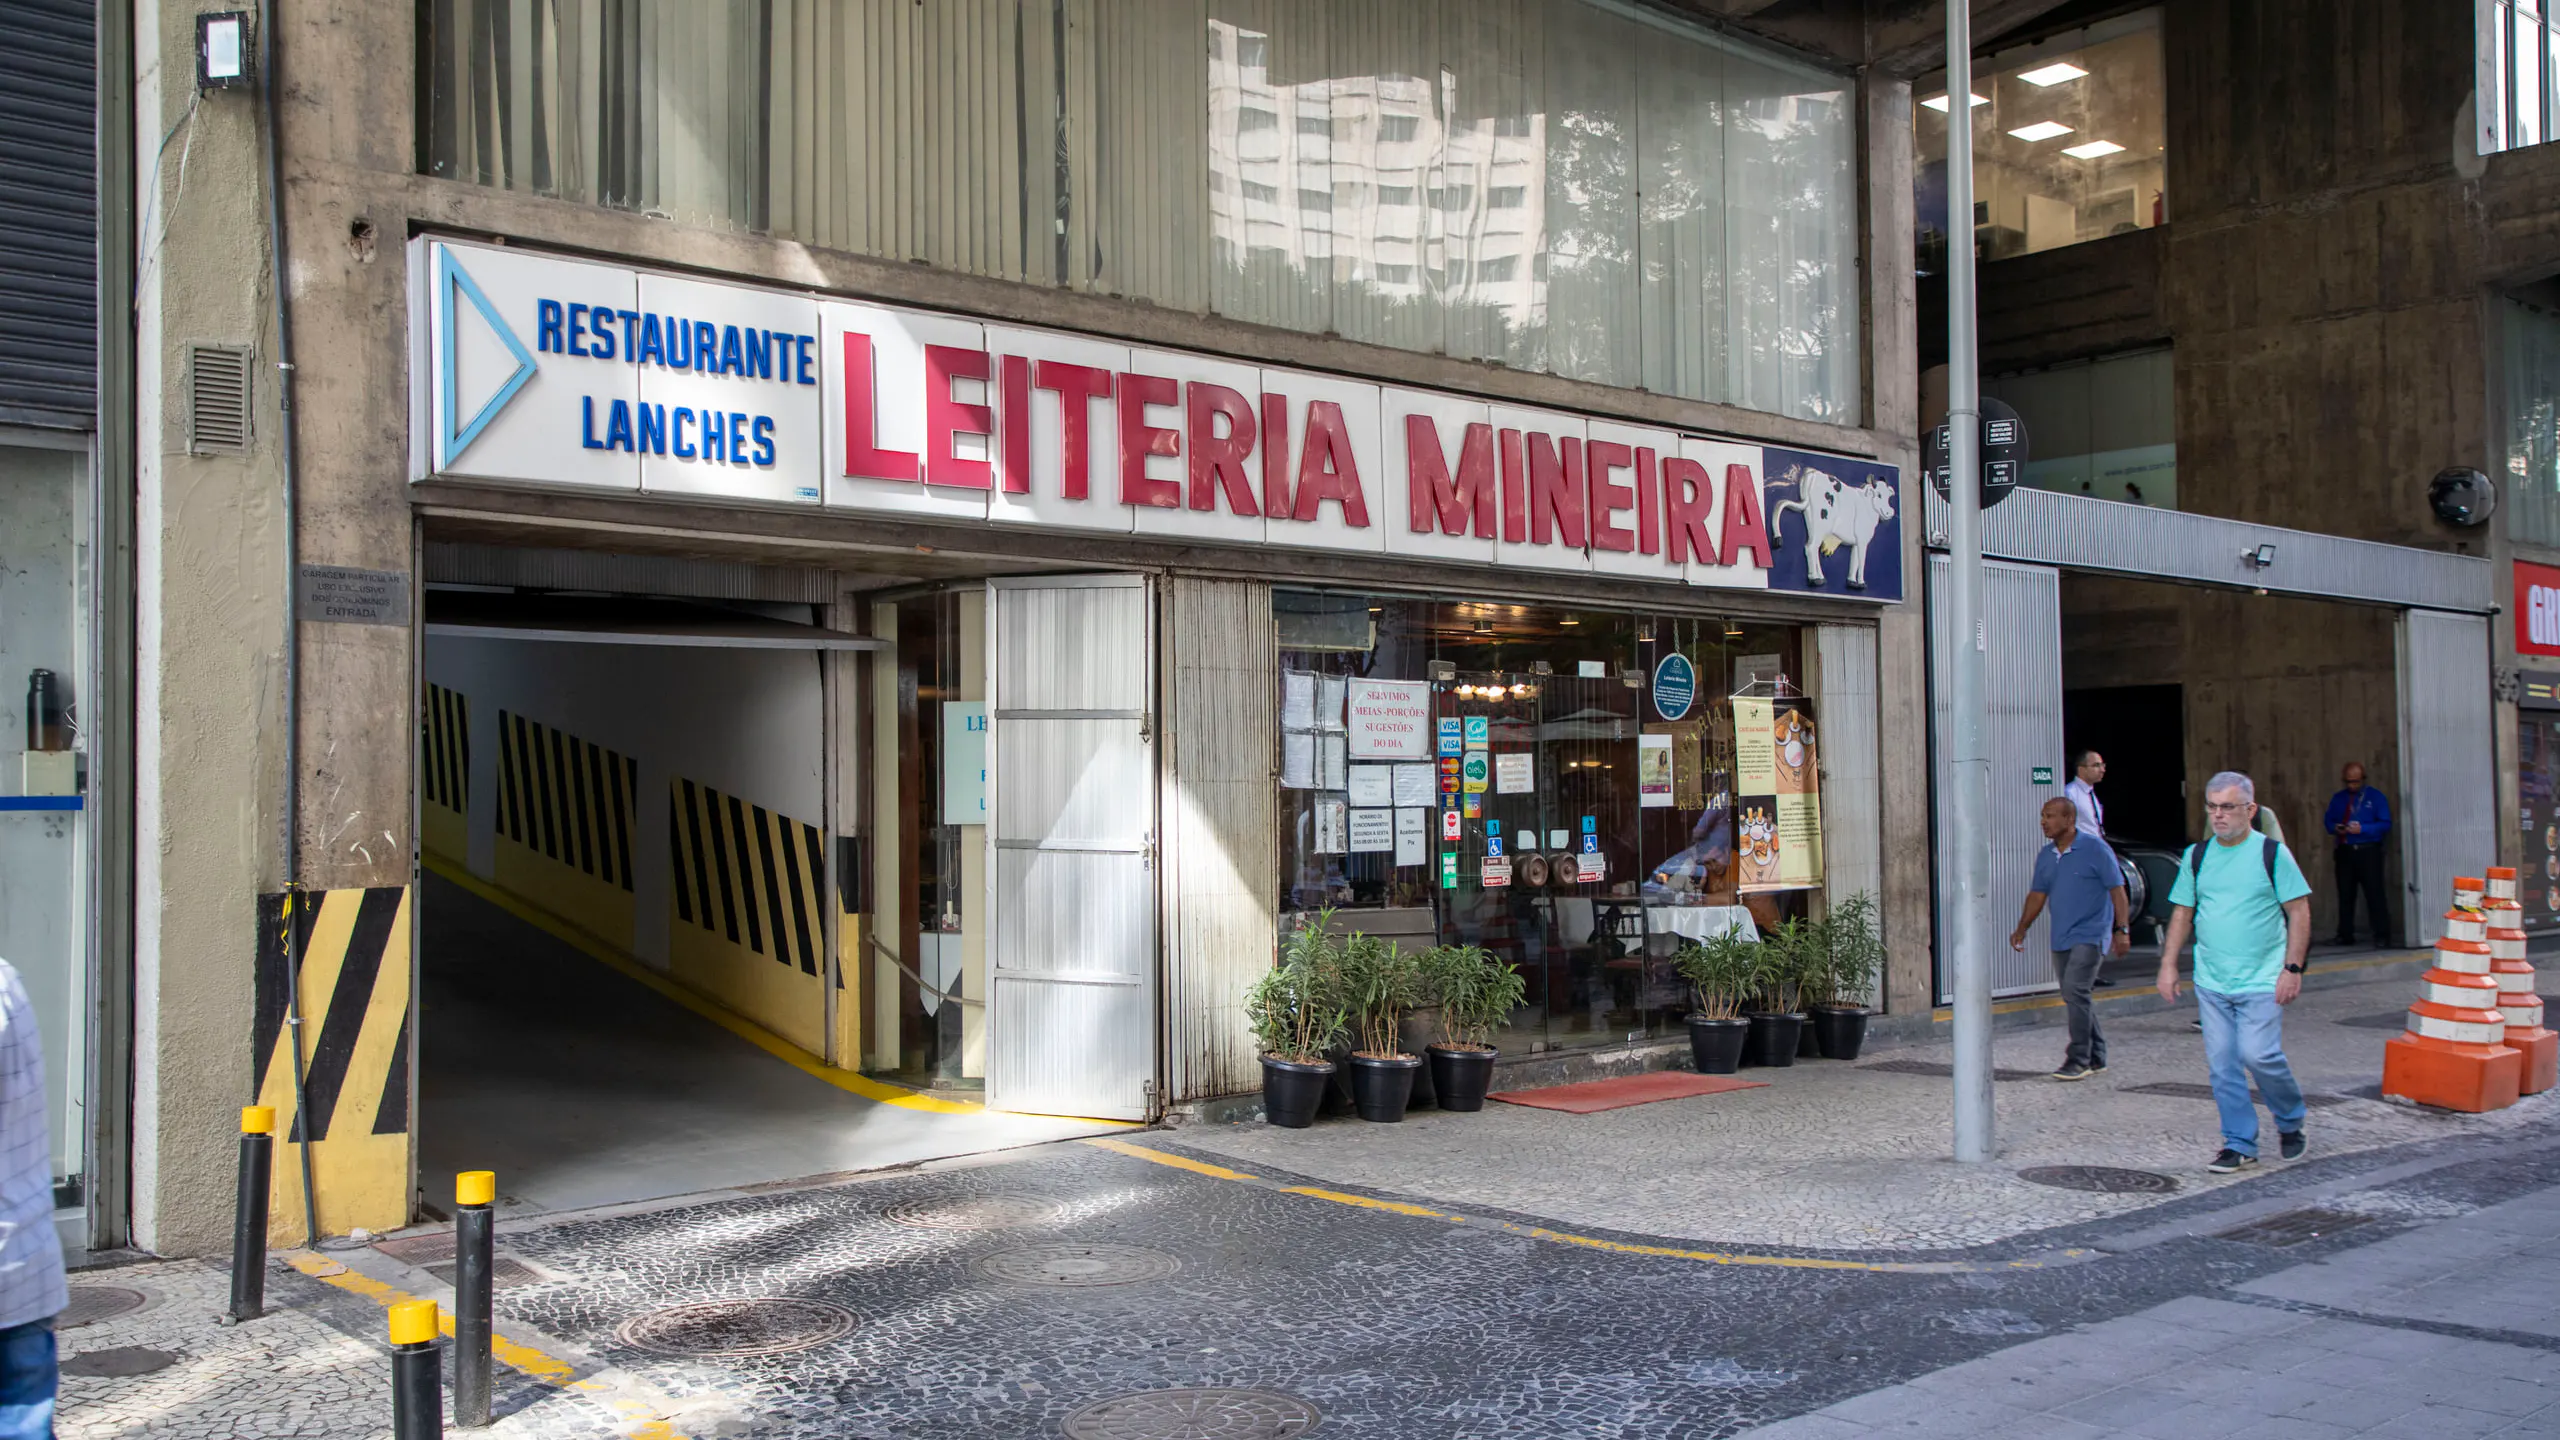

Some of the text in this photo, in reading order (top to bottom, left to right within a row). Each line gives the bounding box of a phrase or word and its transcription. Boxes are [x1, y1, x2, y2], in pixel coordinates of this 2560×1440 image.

[537, 298, 816, 385] RESTAURANTE
[582, 396, 774, 466] LANCHES
[843, 331, 1774, 569] LEITERIA MINEIRA
[302, 569, 400, 584] GARAGEM PARTICULAR
[318, 582, 385, 594] USO EXCLUSIVO
[326, 606, 377, 618] ENTRADA
[1367, 690, 1410, 701] SERVIMOS
[1355, 706, 1382, 716] MEIAS
[1365, 721, 1414, 732] SUGESTÕES
[1442, 721, 1459, 730] VISA
[1373, 738, 1403, 748] DO DIA
[1443, 740, 1460, 749] VISA
[2033, 769, 2051, 780] SAÍDA
